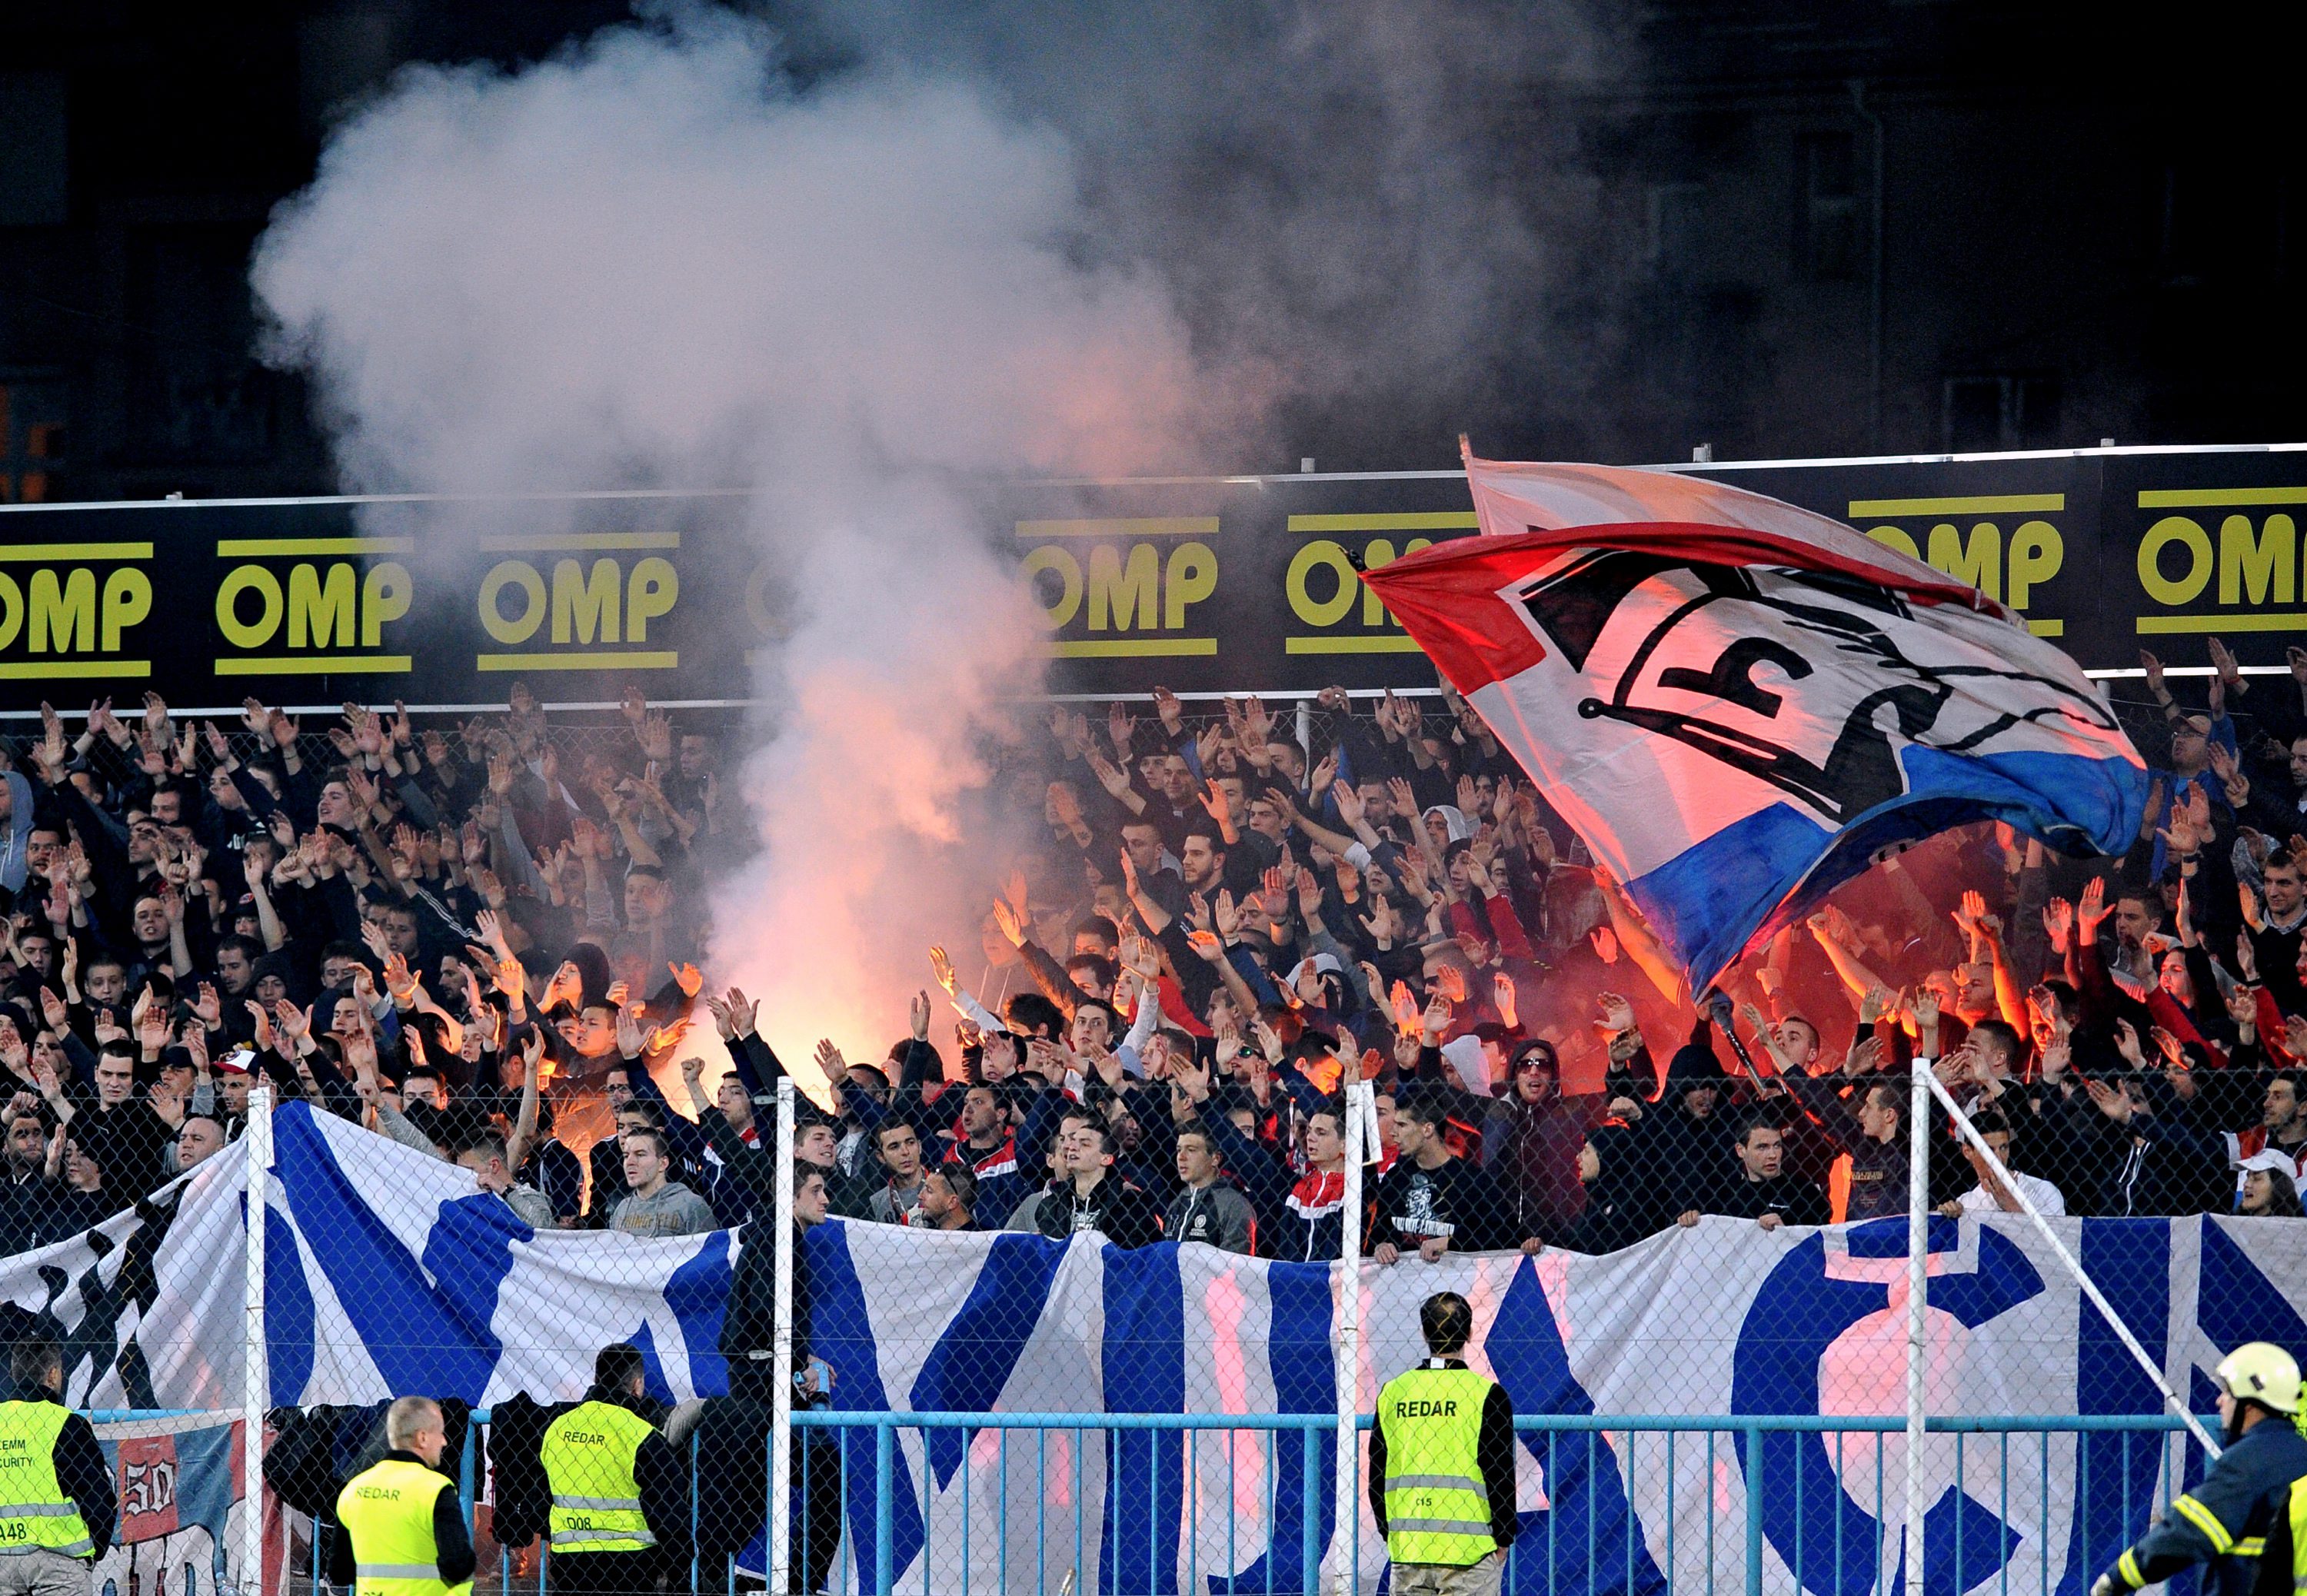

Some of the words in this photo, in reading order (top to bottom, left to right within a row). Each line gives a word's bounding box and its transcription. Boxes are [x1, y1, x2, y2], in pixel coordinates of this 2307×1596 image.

[2137, 514, 2307, 606] OM
[216, 562, 413, 648] OMP
[478, 557, 679, 644] OMP
[1018, 542, 1218, 631] OMP
[1397, 1401, 1456, 1418] REDAR
[564, 1431, 604, 1445] REDAR
[357, 1487, 400, 1501] REDAR
[567, 1518, 591, 1530] D08
